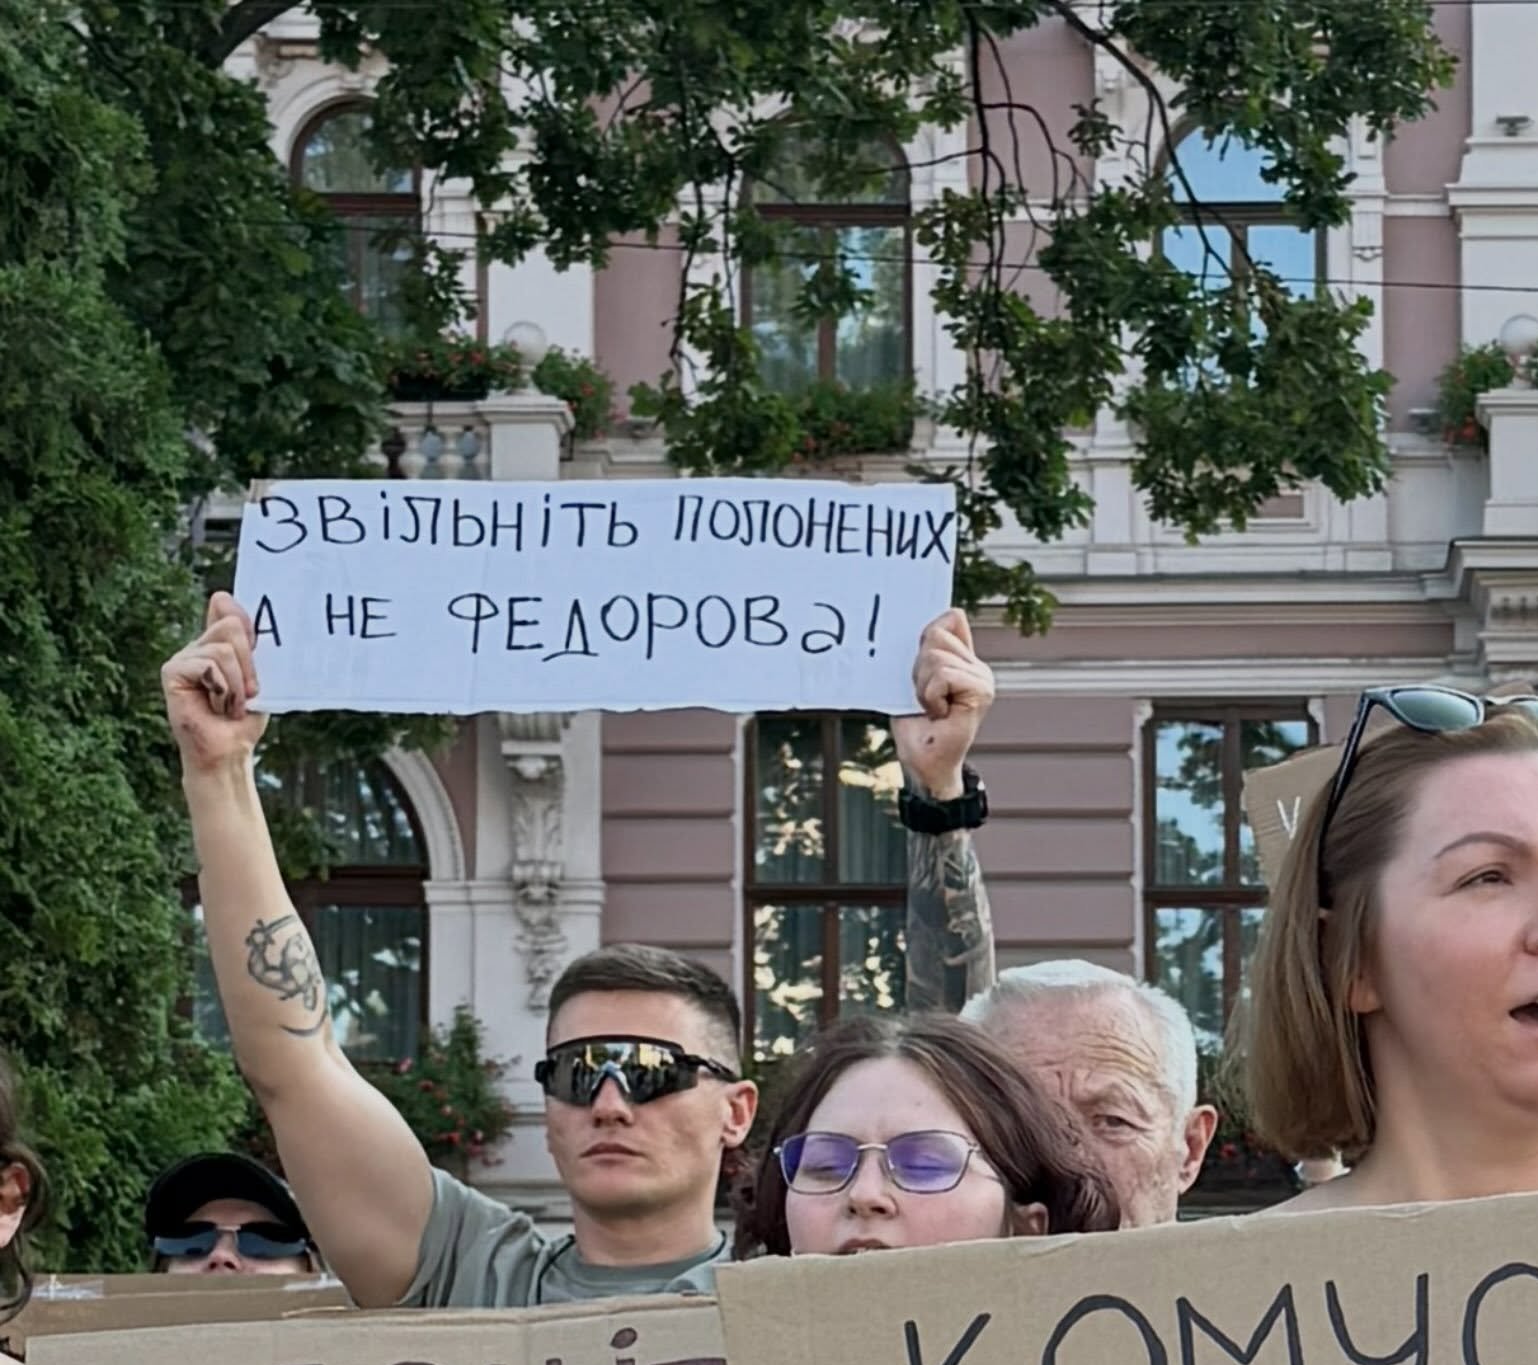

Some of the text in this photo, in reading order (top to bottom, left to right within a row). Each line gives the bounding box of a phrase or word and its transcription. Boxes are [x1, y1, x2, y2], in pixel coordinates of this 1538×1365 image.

[673, 494, 953, 565] ПОЛОНЕНИХ
[252, 594, 282, 648] А
[325, 593, 398, 640] НЕ
